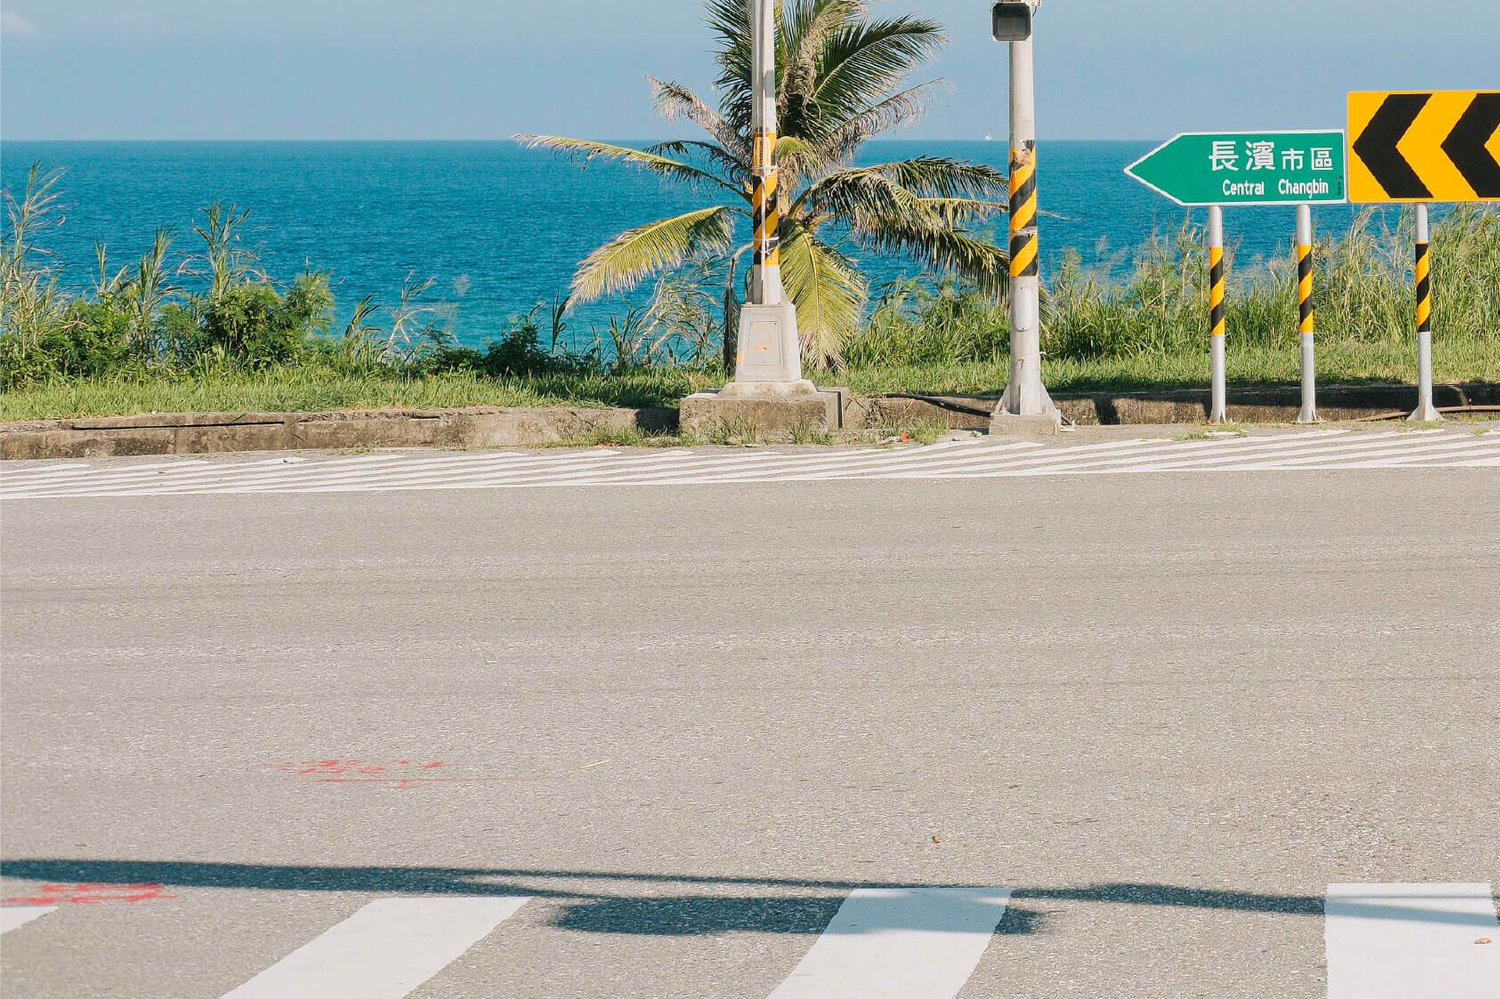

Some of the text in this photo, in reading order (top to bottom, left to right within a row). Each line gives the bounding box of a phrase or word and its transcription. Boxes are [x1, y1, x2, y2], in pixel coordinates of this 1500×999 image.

[1208, 140, 1333, 171] 長濱市區
[1222, 179, 1265, 196] Central
[1278, 178, 1329, 199] Changbin
